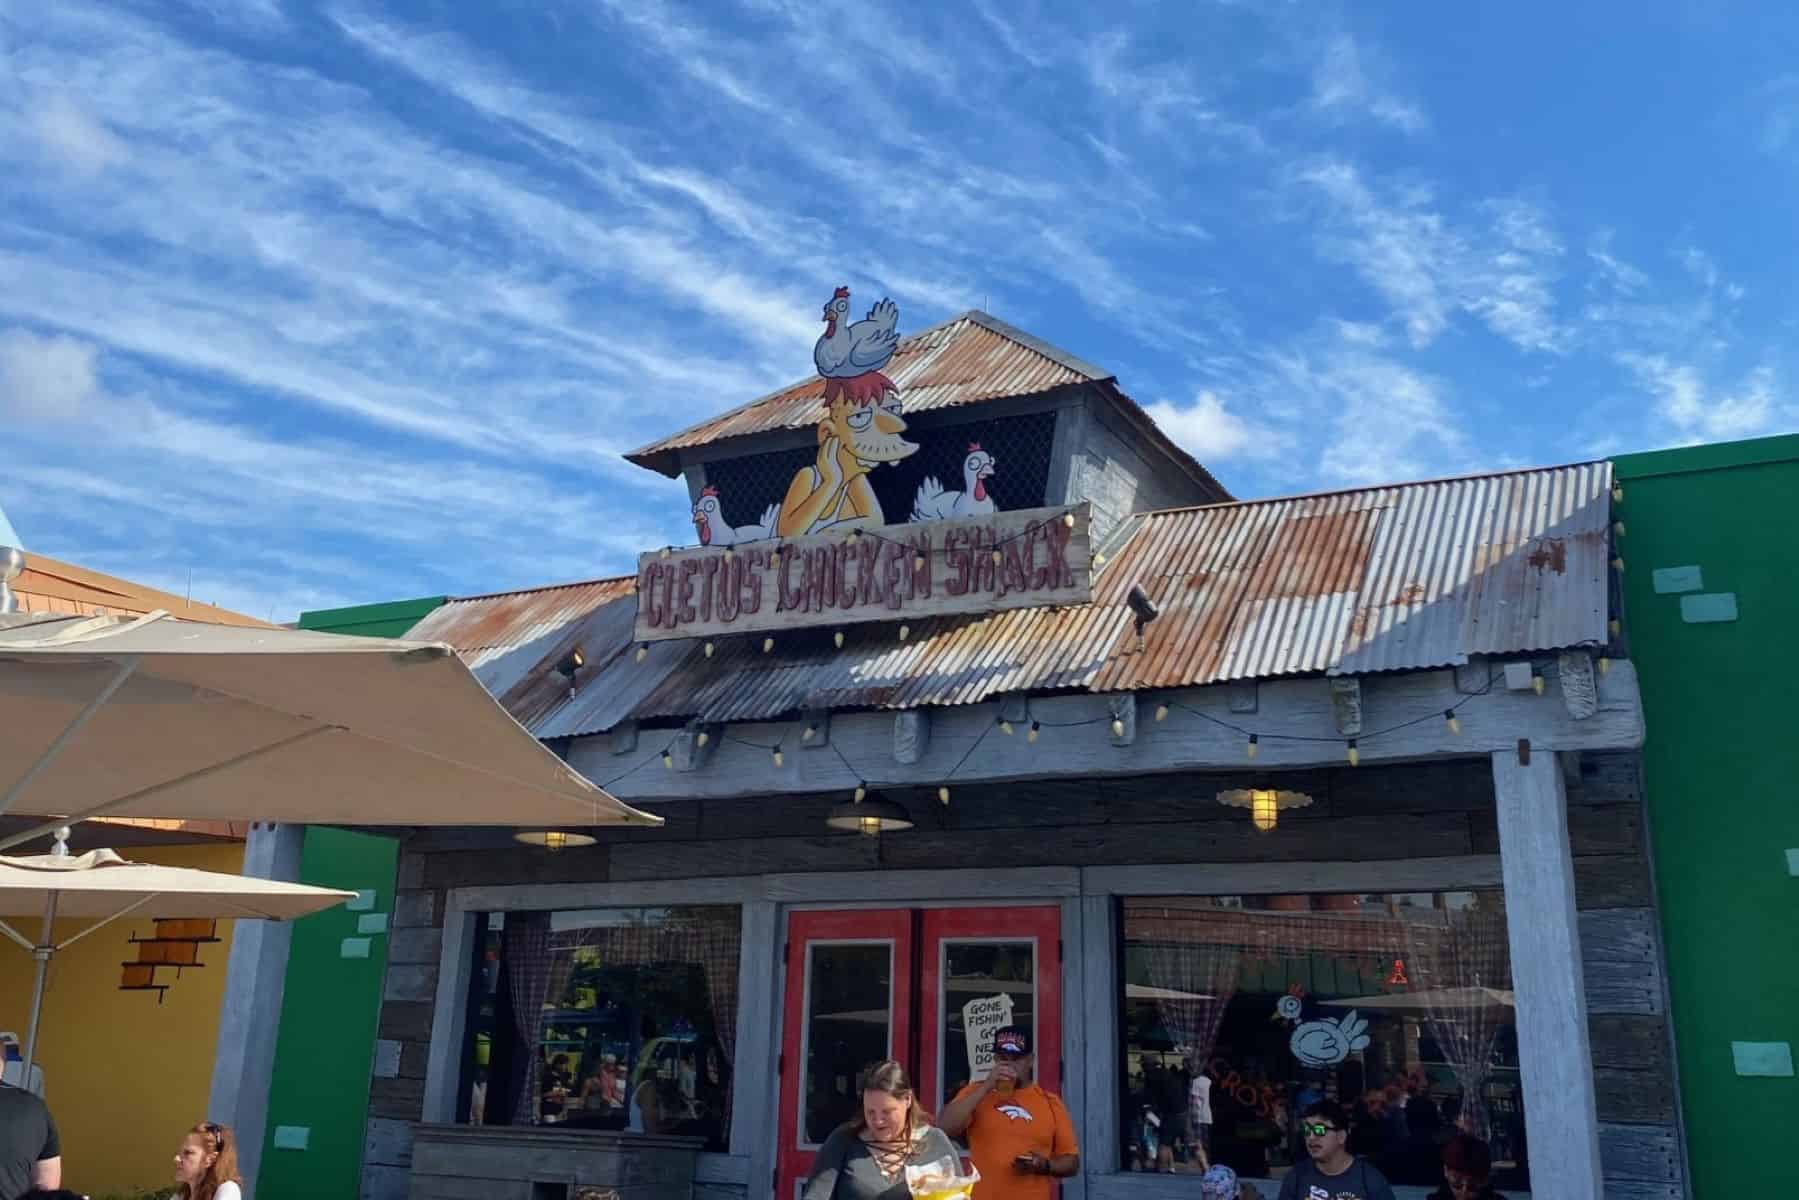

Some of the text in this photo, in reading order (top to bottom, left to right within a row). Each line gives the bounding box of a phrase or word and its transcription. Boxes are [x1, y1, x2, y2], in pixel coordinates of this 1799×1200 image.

[778, 530, 932, 613] CHICKEN
[944, 514, 1074, 597] SHACK
[971, 1001, 1002, 1014] GONE
[968, 1010, 1007, 1027] FISHIN'
[976, 1043, 995, 1053] NE
[976, 1054, 993, 1064] DO
